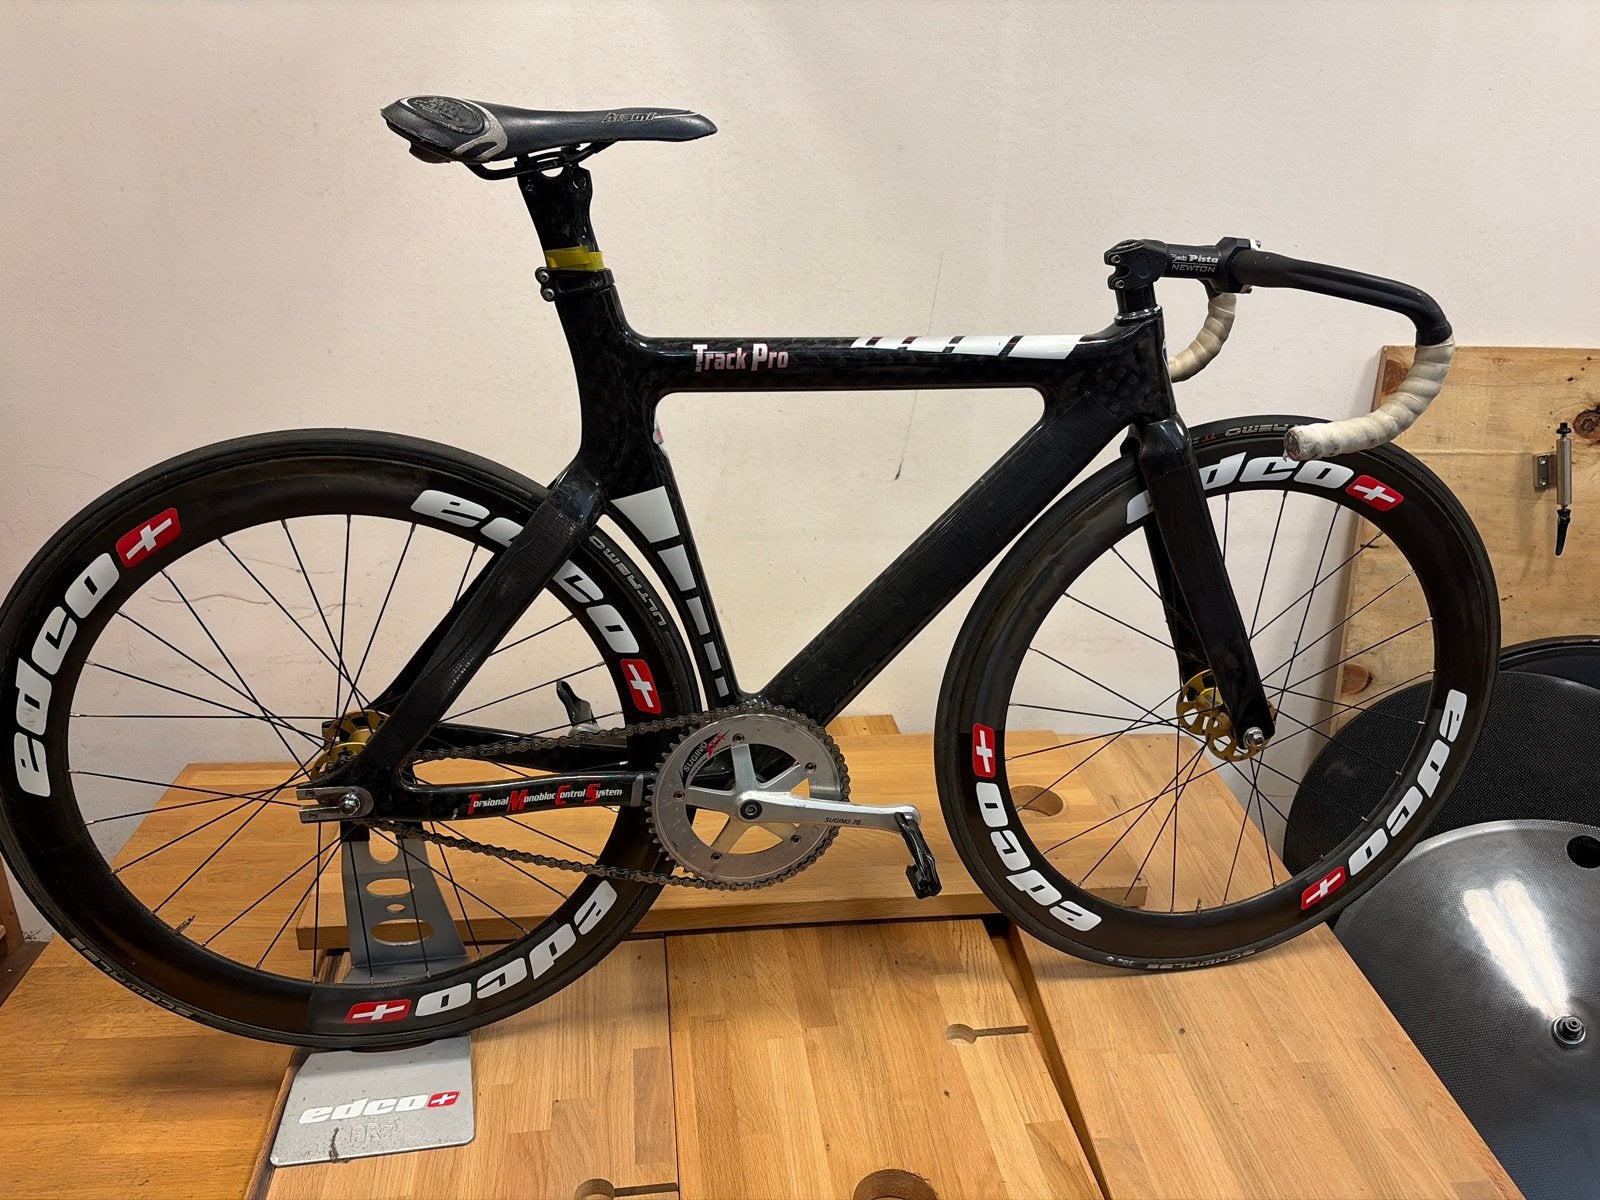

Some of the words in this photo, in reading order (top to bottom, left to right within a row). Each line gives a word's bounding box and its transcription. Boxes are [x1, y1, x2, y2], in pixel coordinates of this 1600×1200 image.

[1171, 263, 1216, 273] NEWTON
[1189, 254, 1219, 264] Pista
[692, 343, 748, 373] Track
[750, 342, 789, 372] Pro
[588, 535, 667, 628] ULTREMO
[13, 552, 120, 798] edco
[683, 741, 708, 773] SUGINO
[1347, 688, 1468, 877] edco
[467, 793, 509, 815] Torsional
[507, 789, 557, 812] Monobloc
[555, 784, 586, 806] Control
[583, 783, 623, 804] System
[824, 816, 851, 825] SUGINO
[975, 781, 1102, 932] edco
[414, 879, 618, 1018] edco
[1145, 949, 1256, 969] SCHWALBE
[298, 1094, 429, 1125] edco
